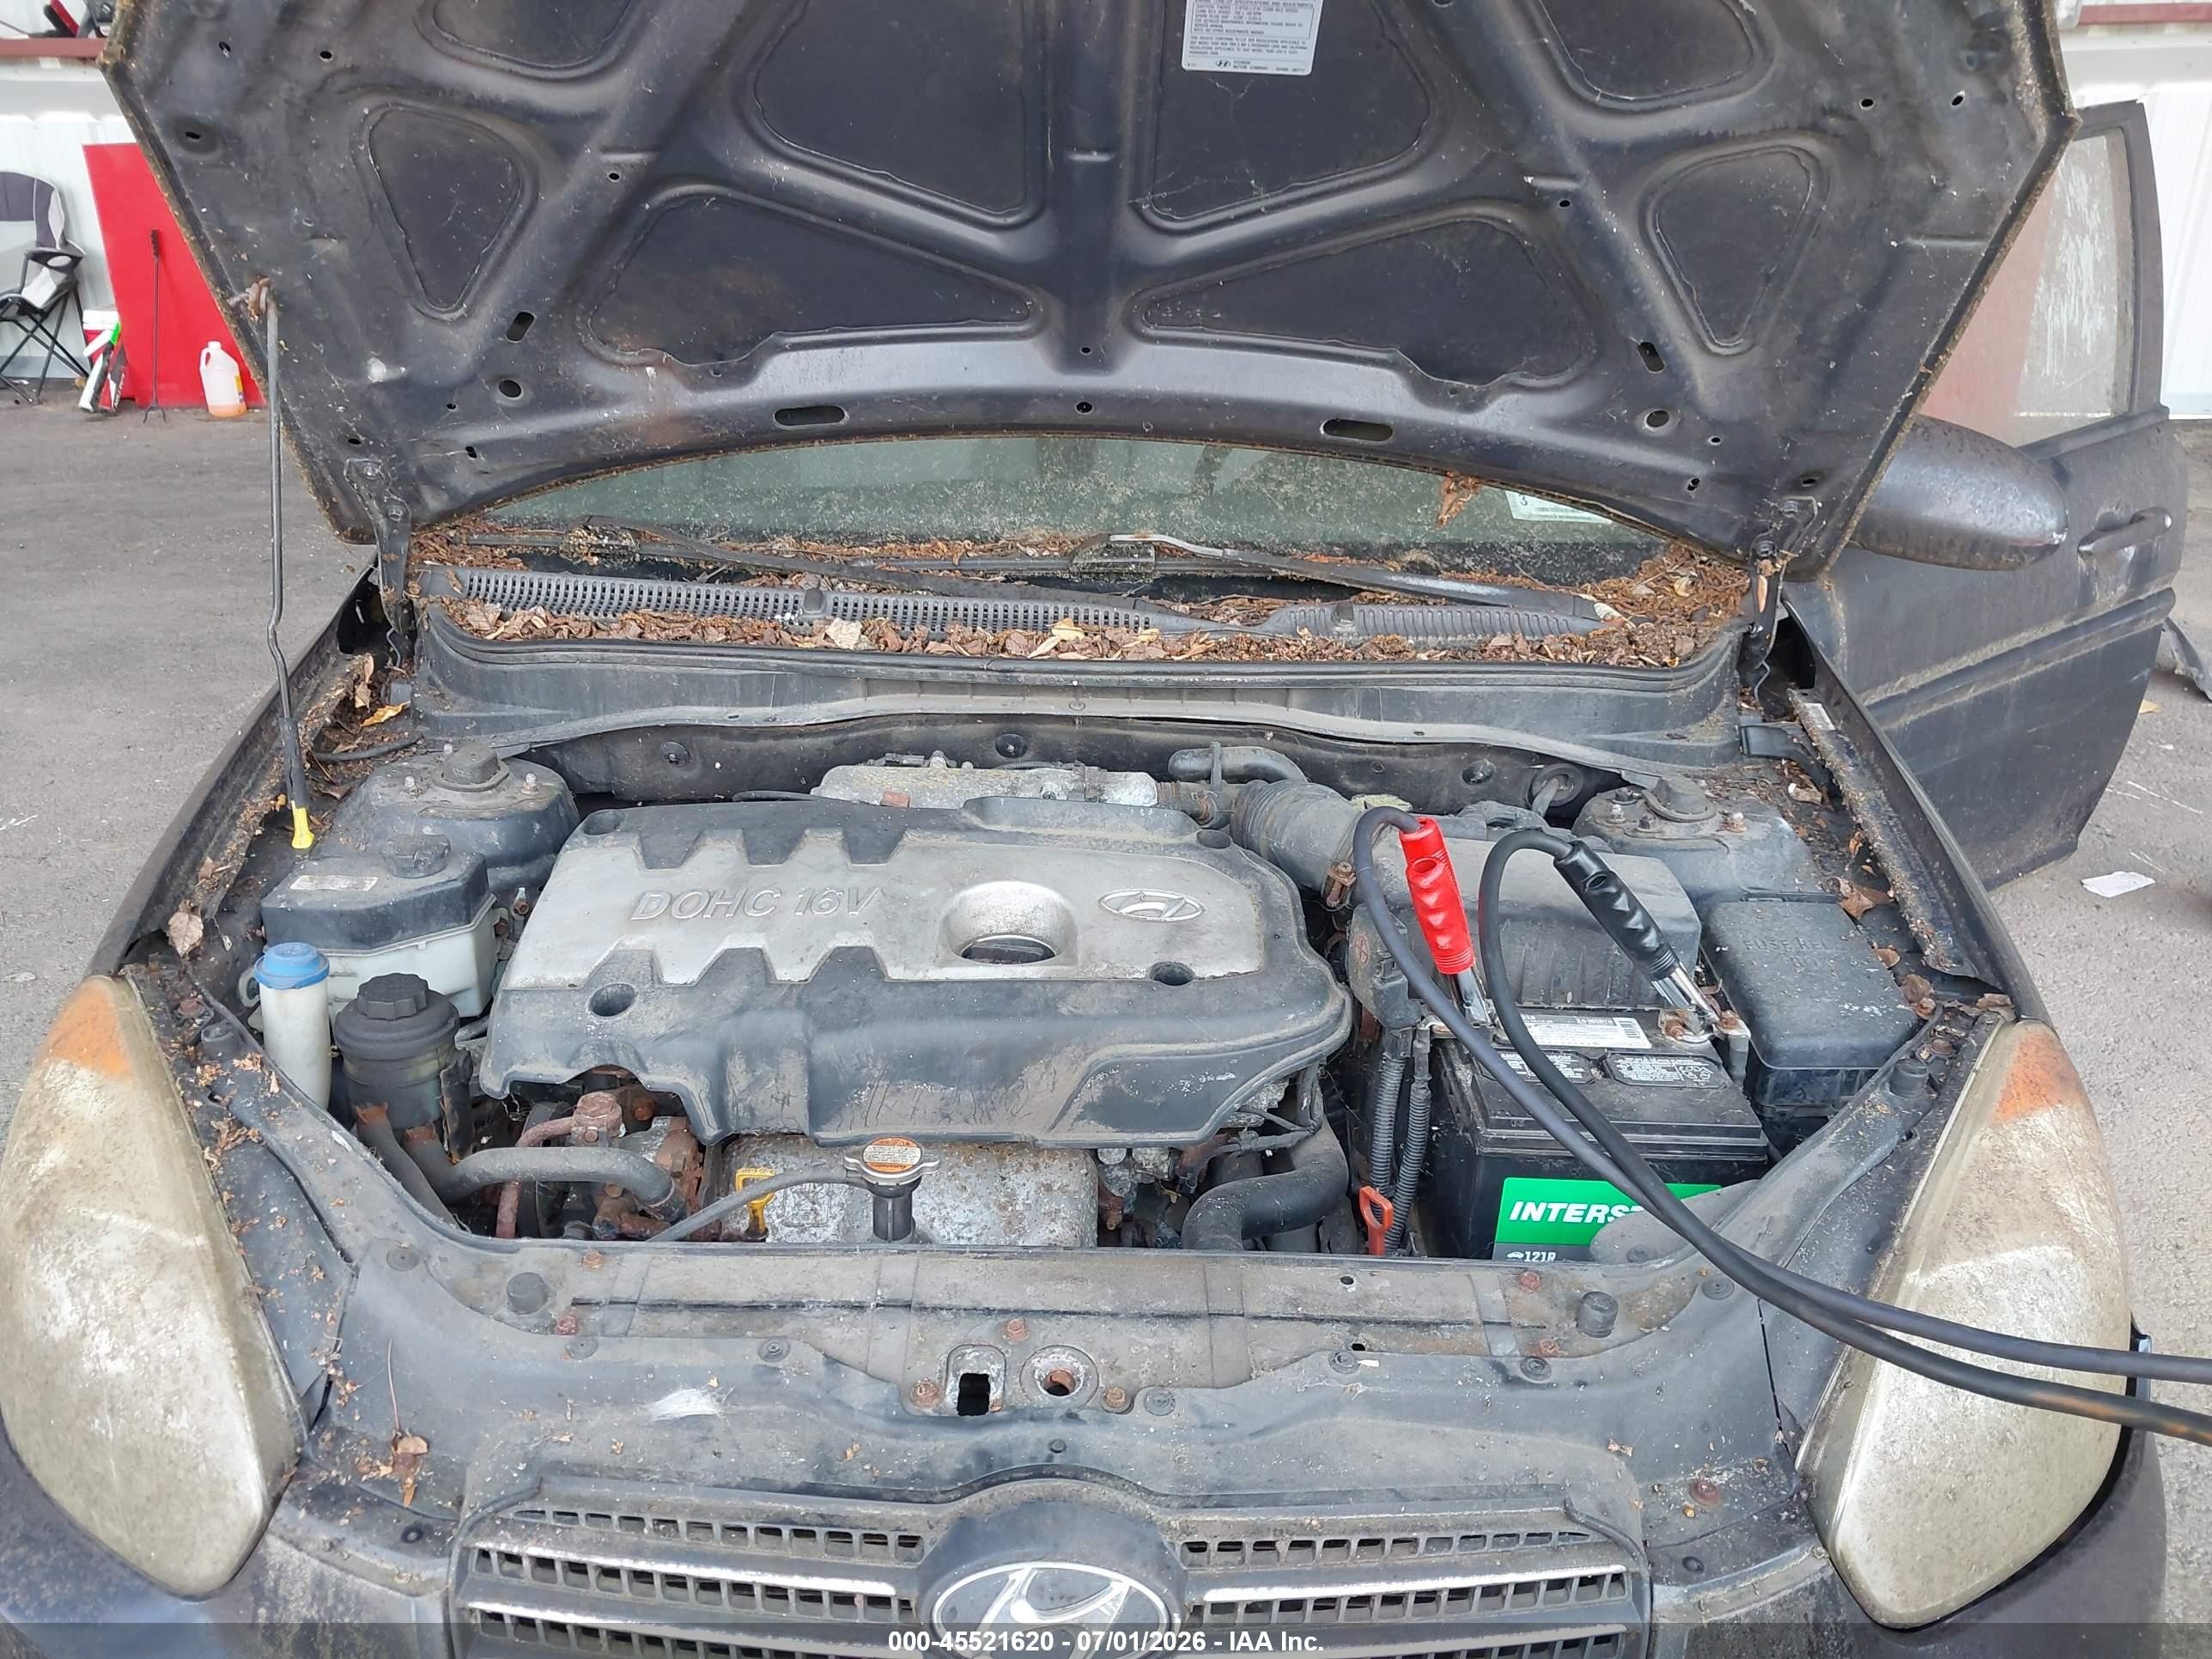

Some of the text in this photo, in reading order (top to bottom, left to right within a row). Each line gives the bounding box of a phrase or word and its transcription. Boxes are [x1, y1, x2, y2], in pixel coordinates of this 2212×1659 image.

[630, 885, 881, 920] DOHC 16V
[1742, 939, 1794, 951] FUSE
[1523, 1251, 1557, 1262] 121R
